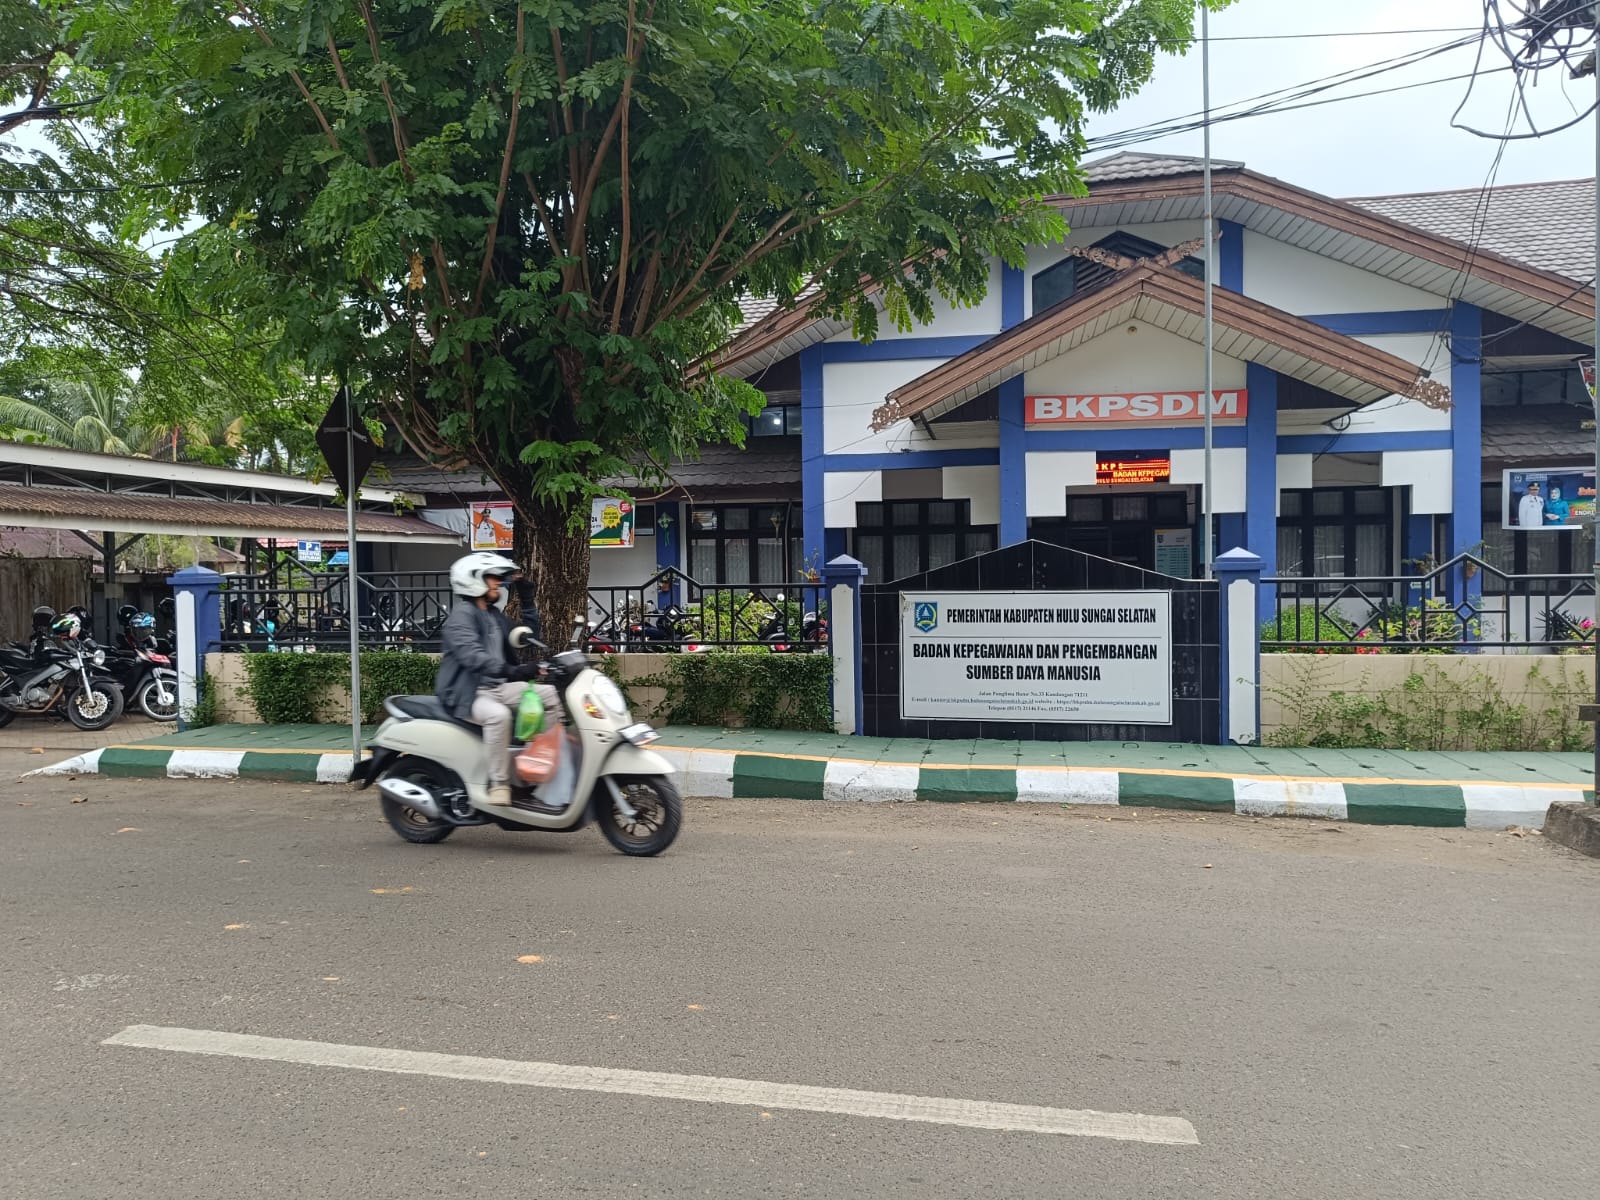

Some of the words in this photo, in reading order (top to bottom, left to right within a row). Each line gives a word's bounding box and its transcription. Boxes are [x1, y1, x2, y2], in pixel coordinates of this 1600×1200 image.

[1034, 392, 1238, 419] BKPSDM
[946, 608, 1002, 624] PEMERINTAH
[1003, 608, 1055, 624] KABUPATEN
[1056, 608, 1080, 624] HULU
[1081, 608, 1116, 624] SUNGAI
[1117, 608, 1156, 624] SELATAN
[913, 643, 951, 659] BADAN
[953, 643, 1034, 660] KEPEGAWAIAN
[1036, 643, 1060, 660] DAN
[1062, 643, 1158, 660] PENGEMBANGAN
[966, 664, 1014, 681] SUMBER
[1016, 665, 1045, 681] DAYA
[1047, 665, 1101, 681] MANUSIA
